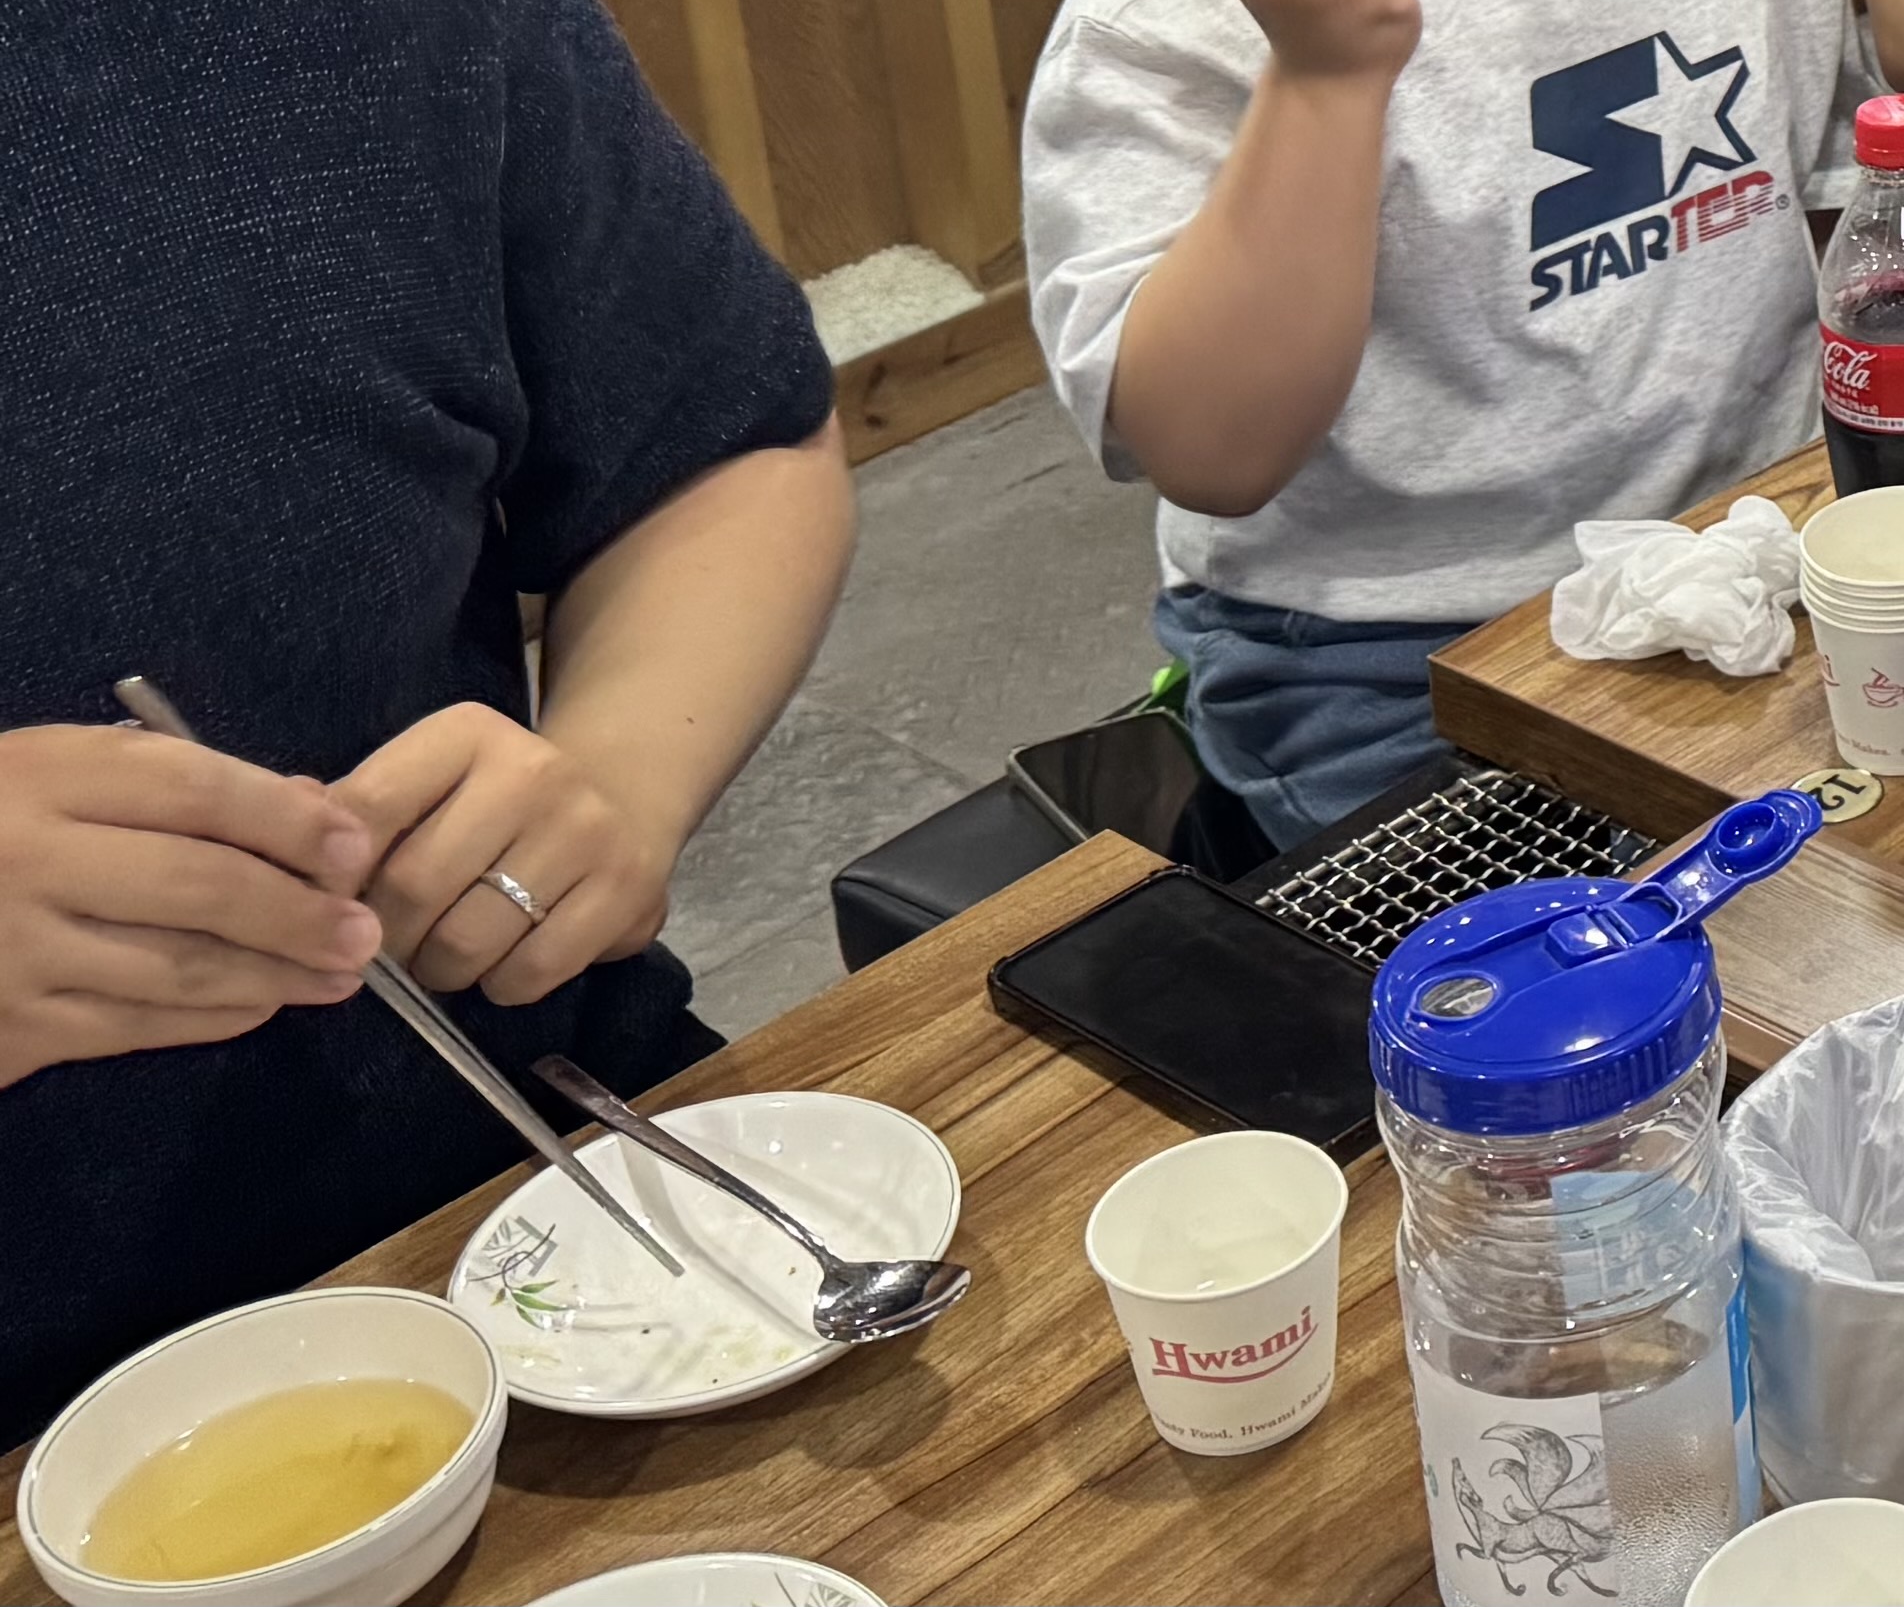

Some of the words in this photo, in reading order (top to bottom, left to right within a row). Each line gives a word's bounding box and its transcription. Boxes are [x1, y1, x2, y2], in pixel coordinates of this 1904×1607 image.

[1529, 169, 1775, 312] STARTER
[1823, 341, 1879, 390] Cola
[1149, 1305, 1319, 1384] Hwami
[1240, 1405, 1297, 1438] Hwami
